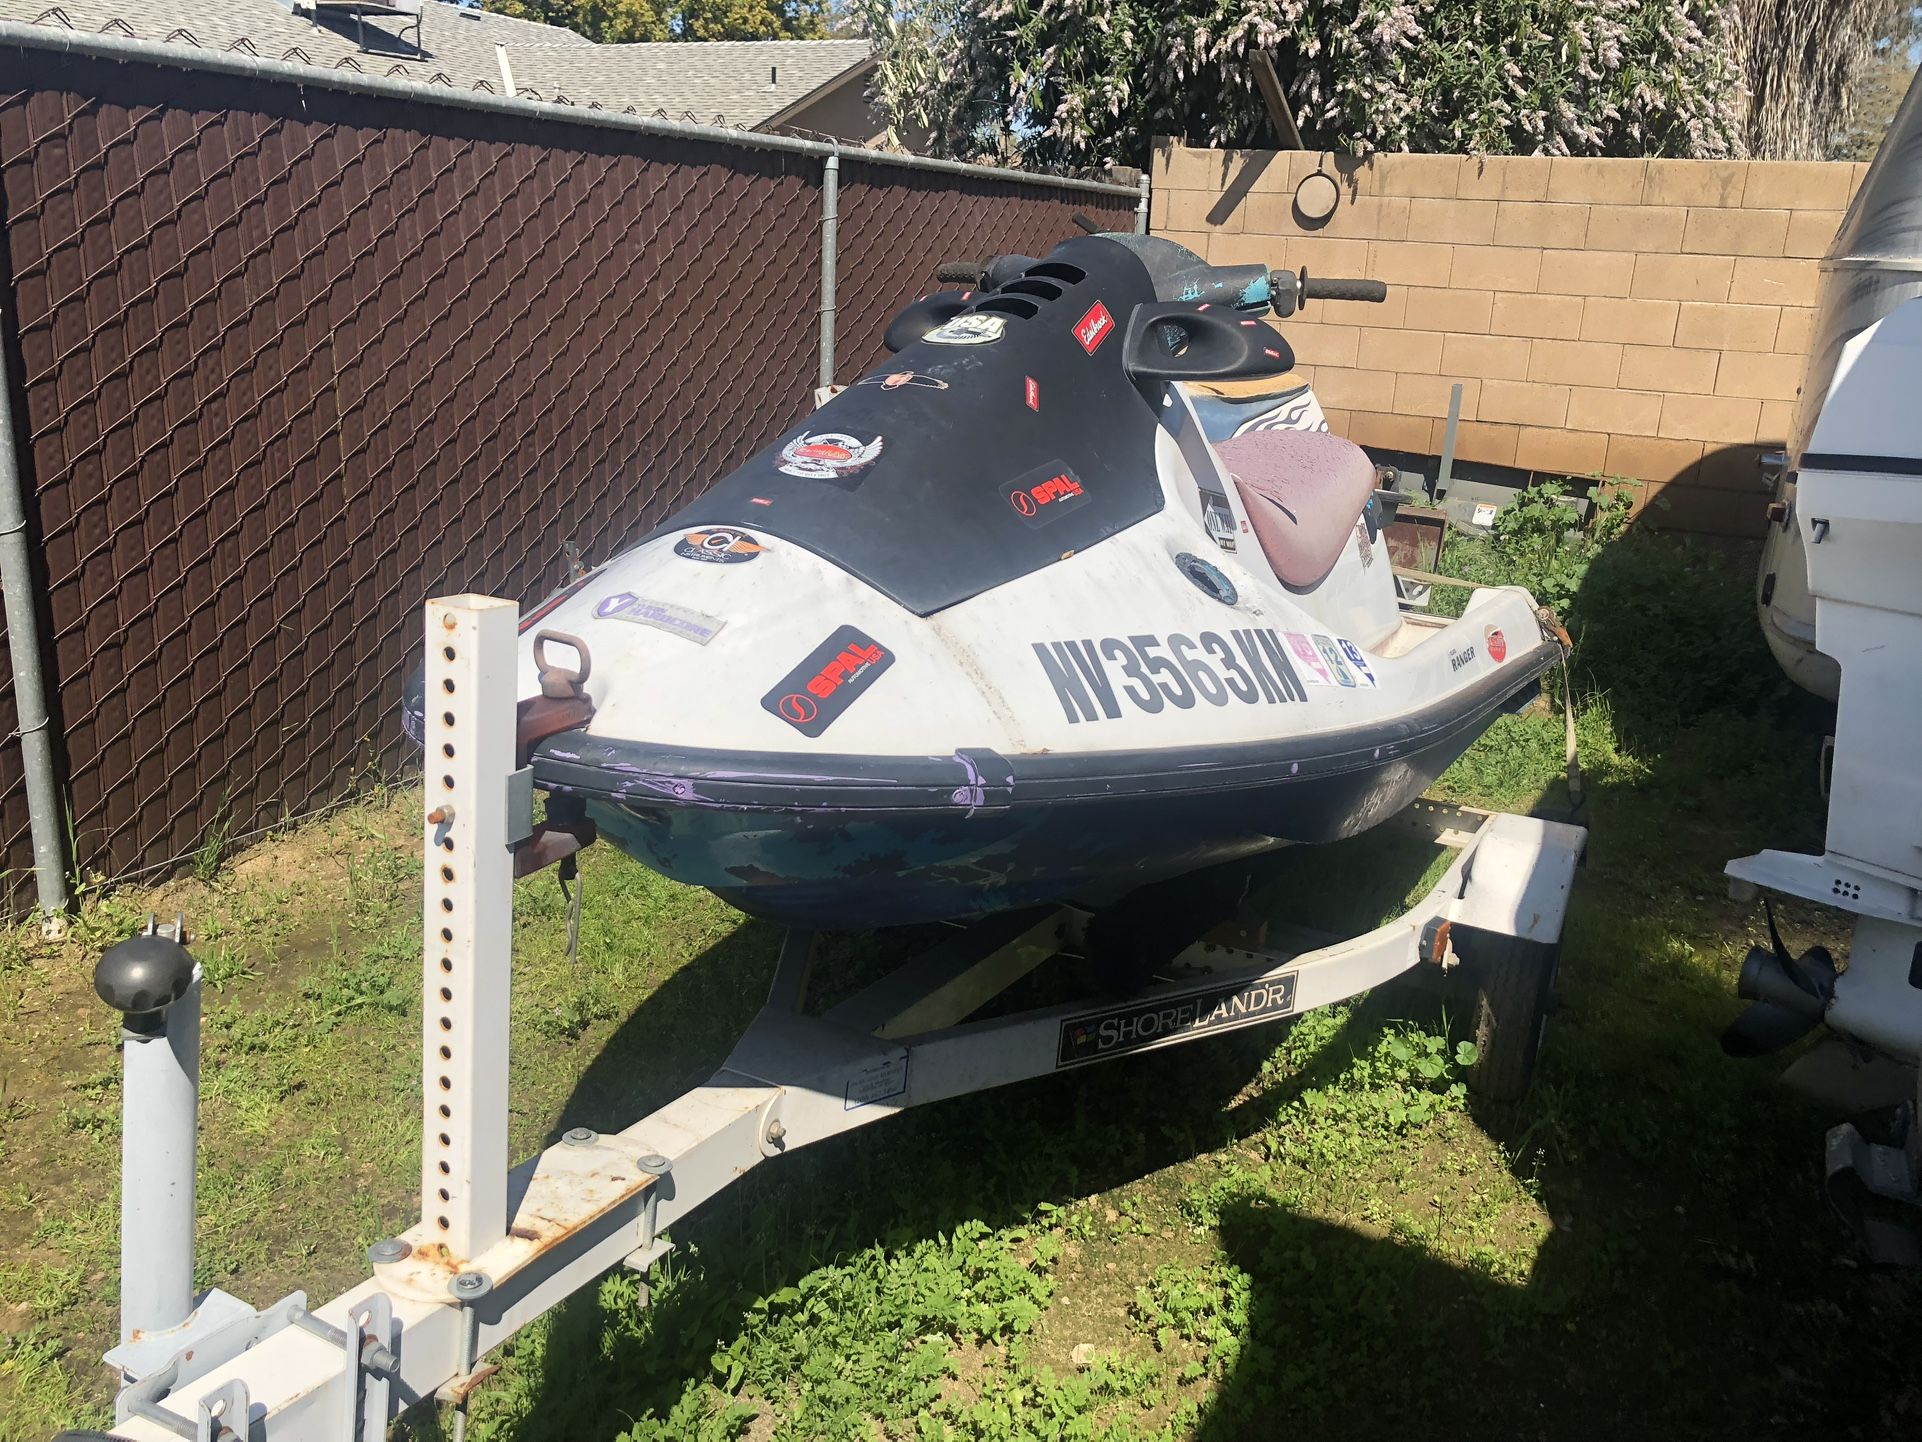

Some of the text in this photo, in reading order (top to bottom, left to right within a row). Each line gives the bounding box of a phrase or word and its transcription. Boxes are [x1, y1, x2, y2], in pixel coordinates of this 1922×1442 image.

[1030, 474, 1080, 505] SPAL
[867, 649, 885, 665] USA
[1341, 639, 1362, 661] 13
[1450, 645, 1476, 673] RANGER
[806, 643, 879, 699] SPAL
